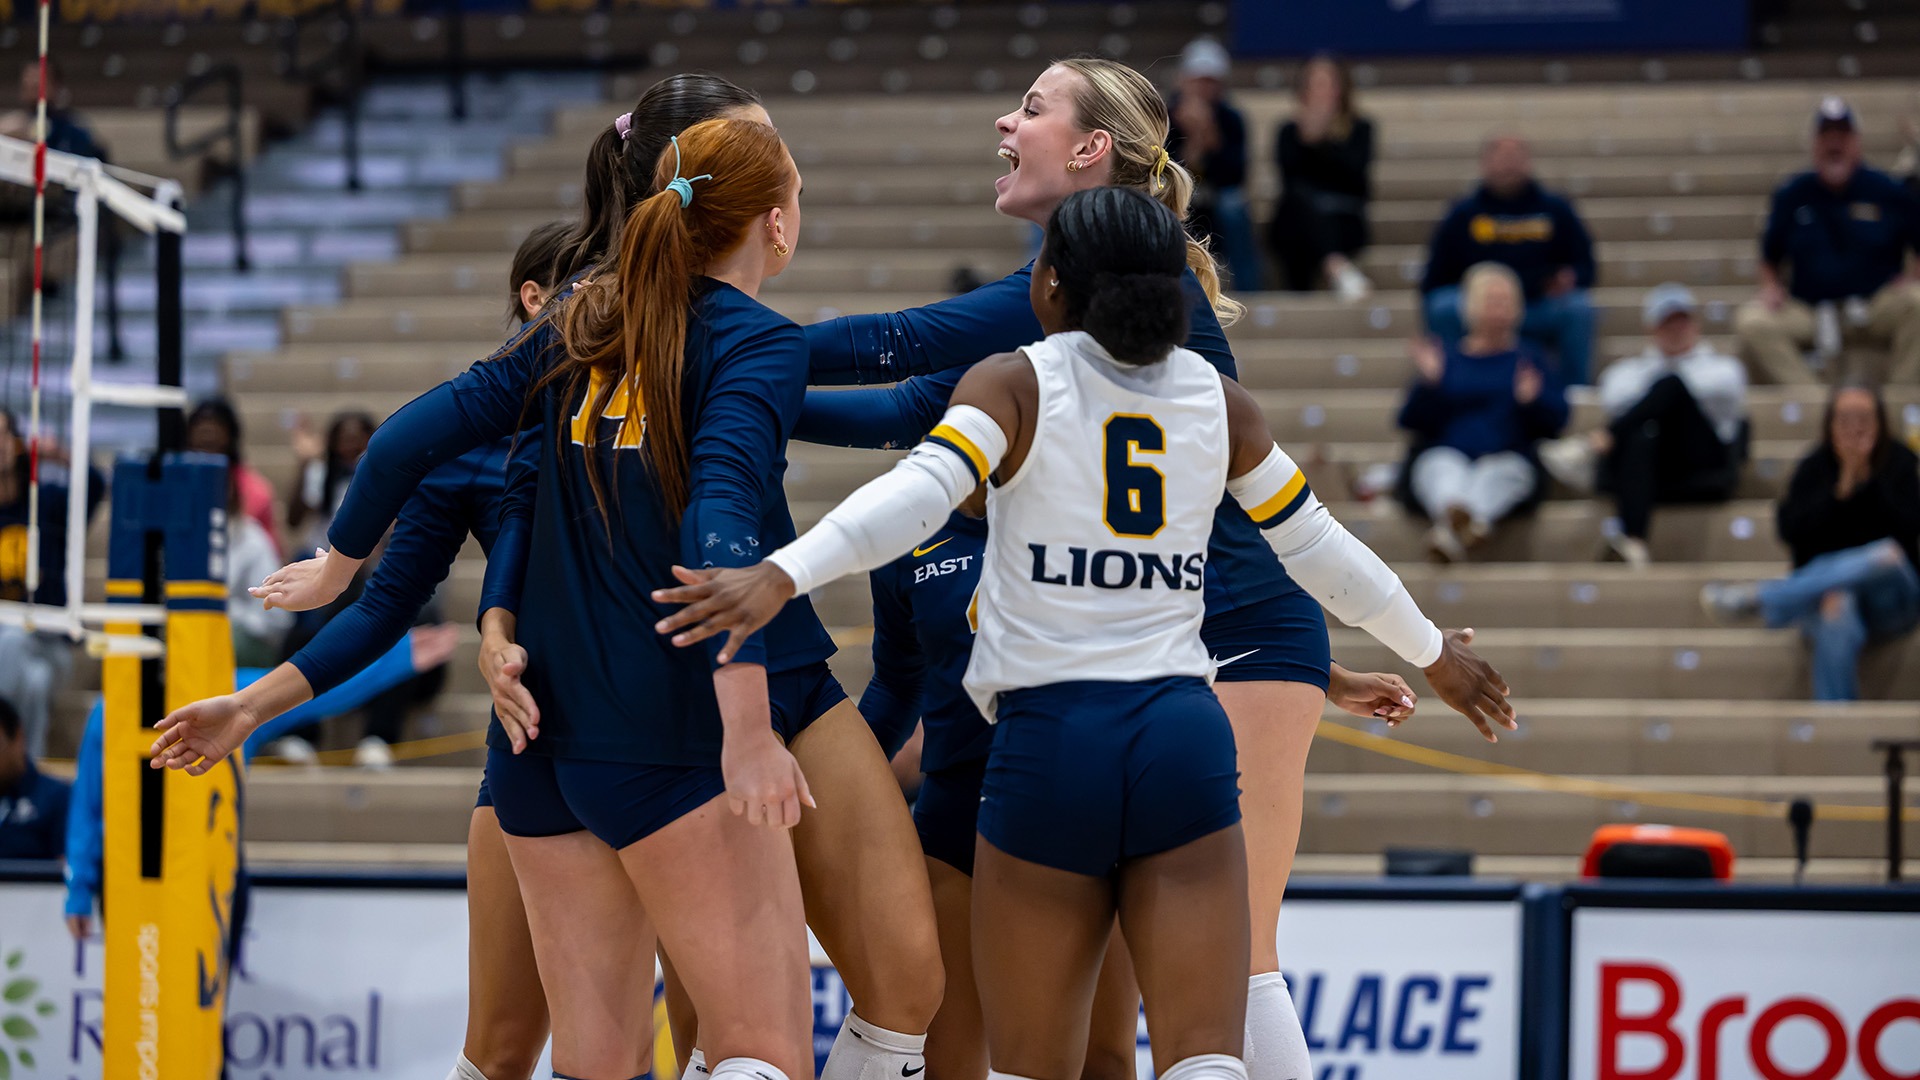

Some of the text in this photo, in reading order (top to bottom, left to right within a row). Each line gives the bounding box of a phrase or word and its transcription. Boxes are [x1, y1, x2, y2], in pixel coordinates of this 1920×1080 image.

[1102, 411, 1167, 540] 6
[913, 555, 973, 584] EAST
[1028, 543, 1205, 592] LIONS
[1283, 974, 1492, 1053] LACE
